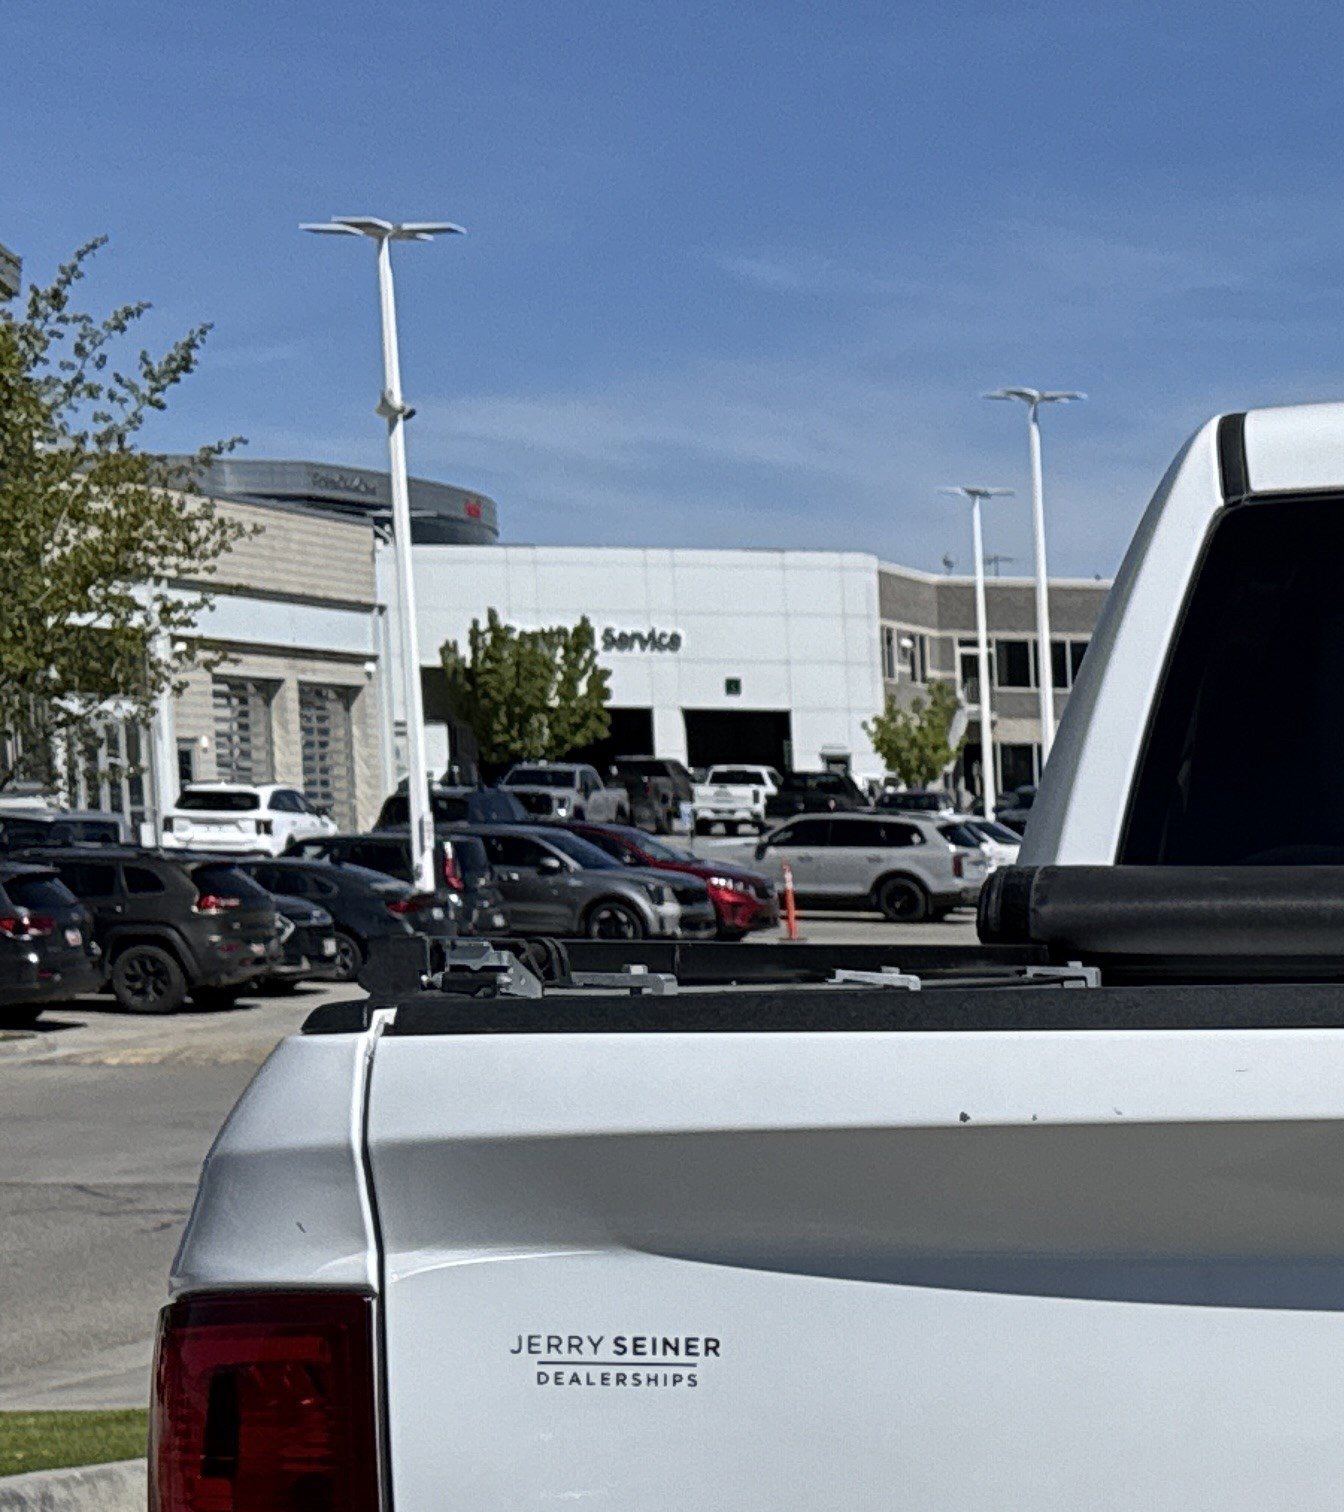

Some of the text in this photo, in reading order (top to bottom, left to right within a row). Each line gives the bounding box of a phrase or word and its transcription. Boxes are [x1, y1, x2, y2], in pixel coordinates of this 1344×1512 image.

[602, 626, 682, 653] Service
[509, 1334, 721, 1357] JERRY SEINER
[536, 1371, 698, 1388] DEALERSHIPS
